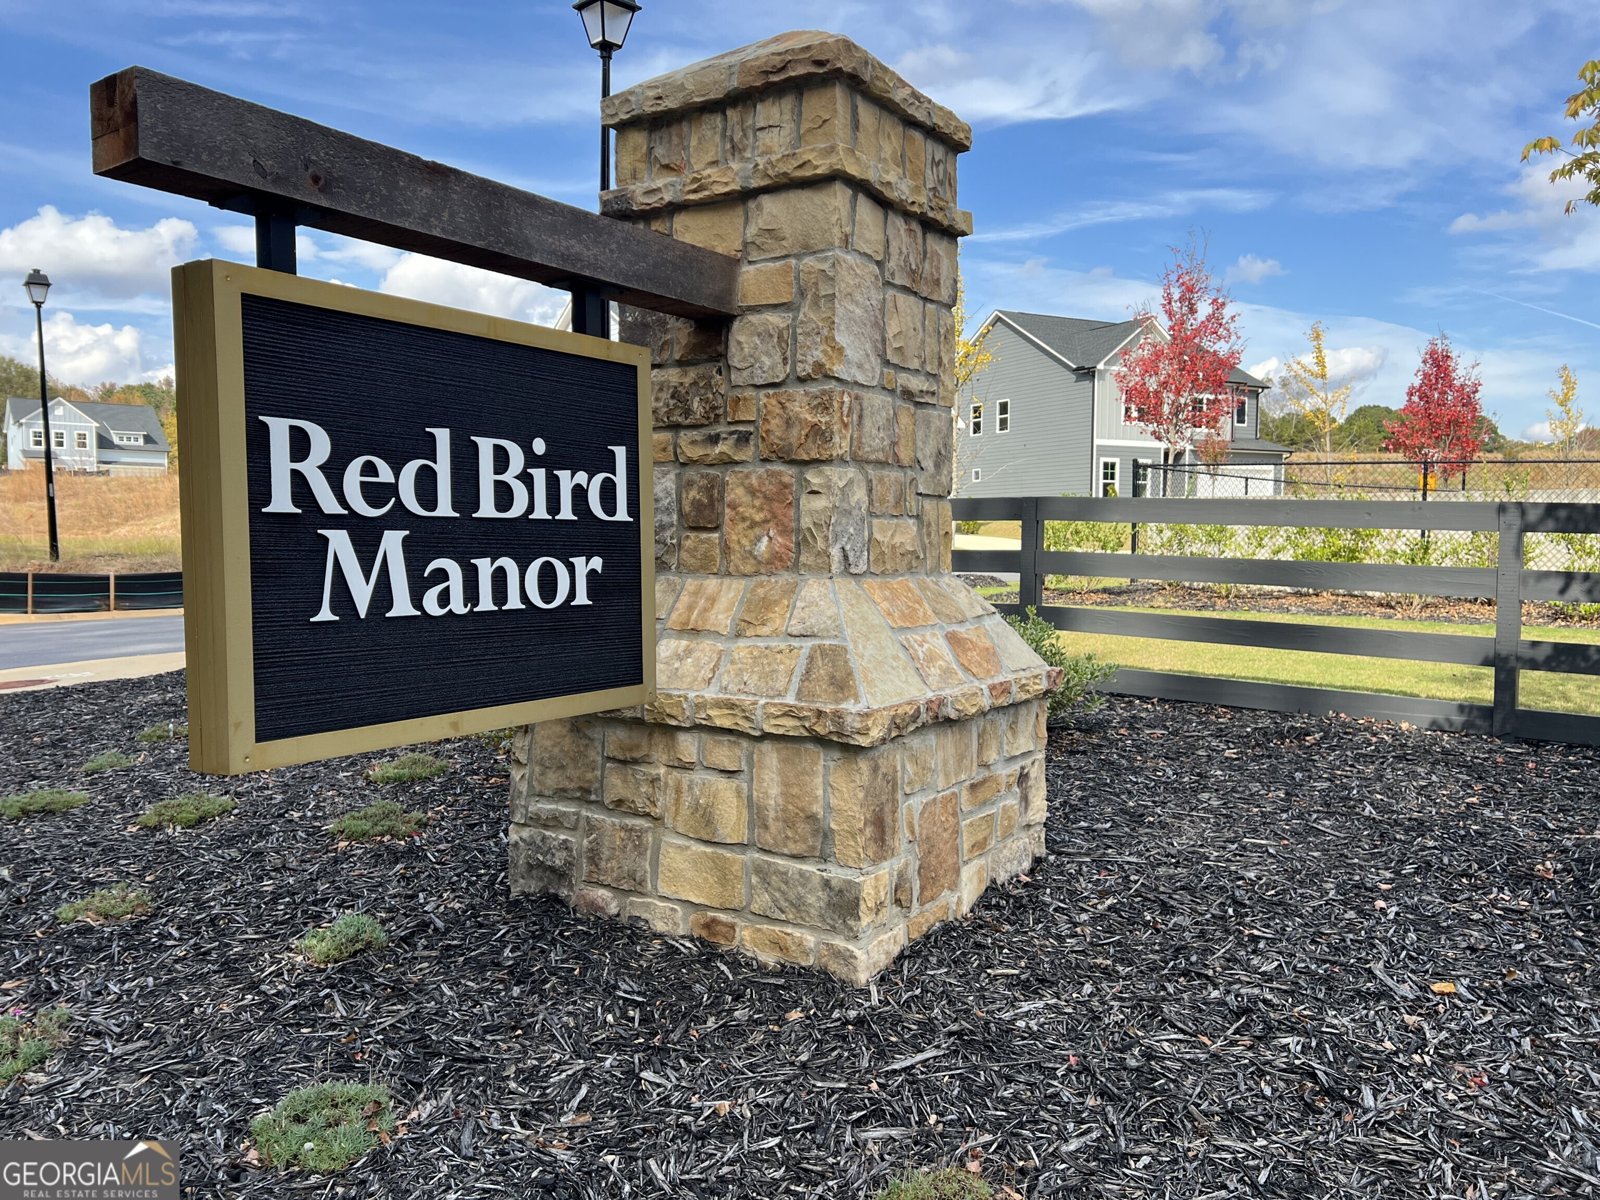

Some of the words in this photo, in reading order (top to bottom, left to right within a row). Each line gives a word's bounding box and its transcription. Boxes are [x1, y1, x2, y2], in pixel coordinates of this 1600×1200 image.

[258, 415, 460, 518] Red
[470, 437, 634, 522] Bird
[310, 529, 604, 622] Manor
